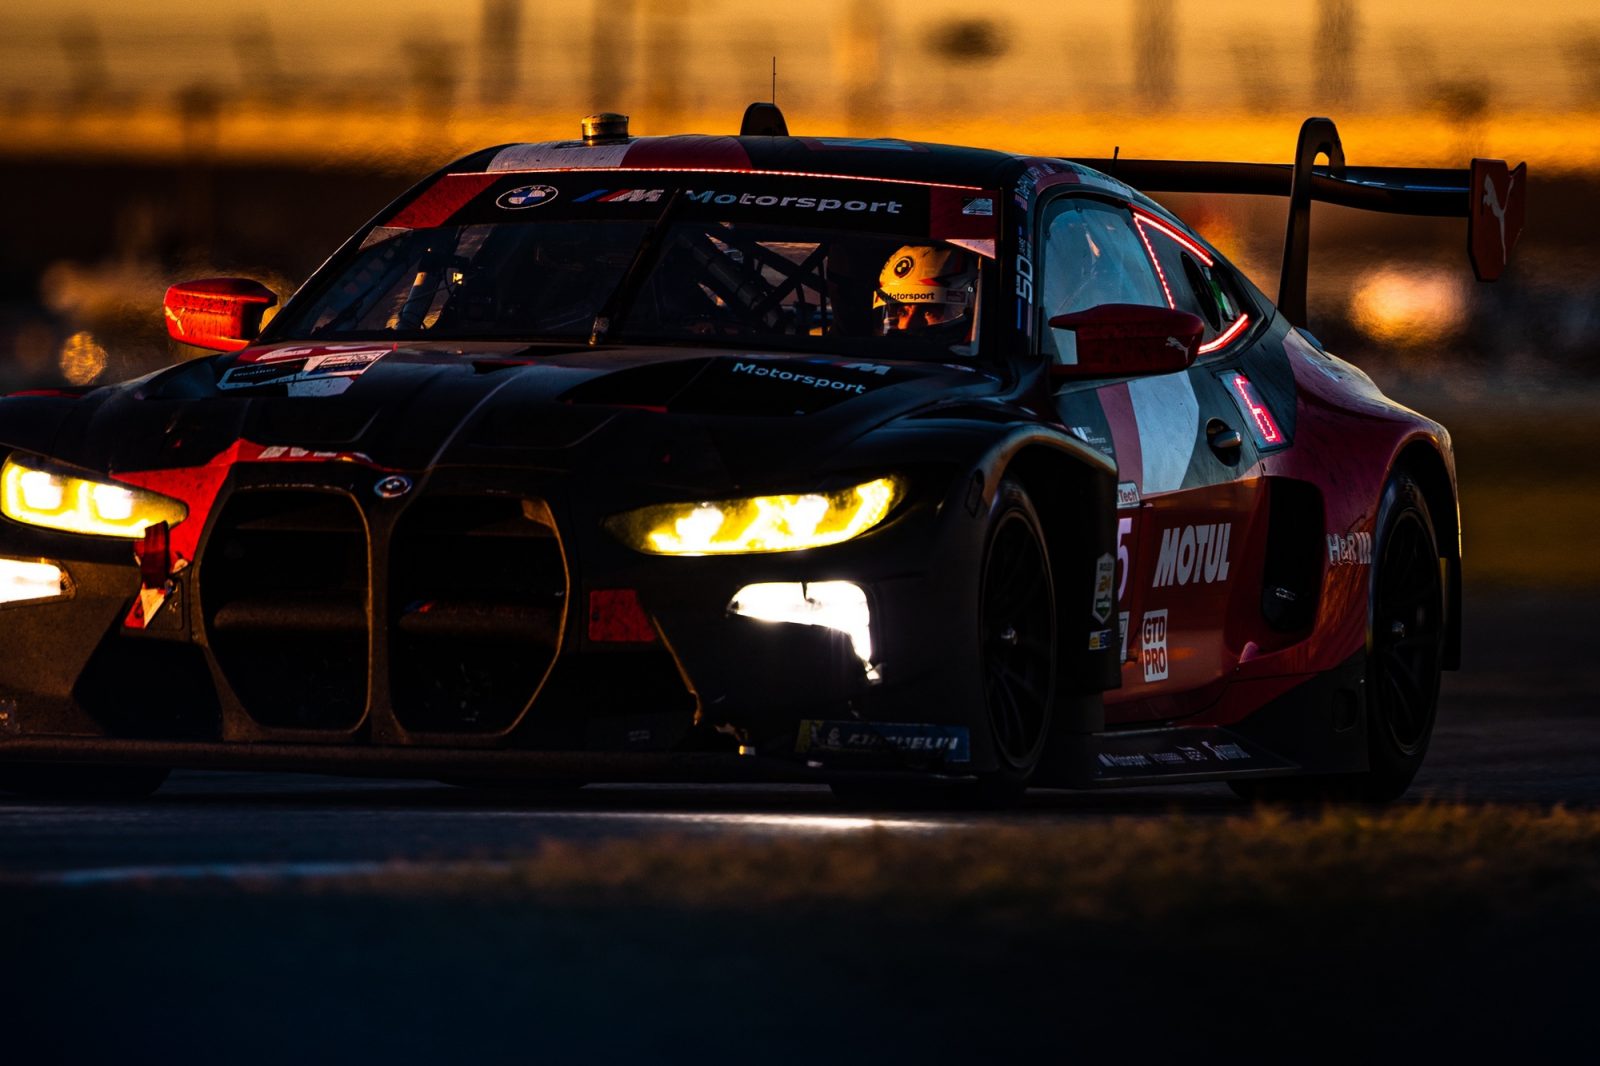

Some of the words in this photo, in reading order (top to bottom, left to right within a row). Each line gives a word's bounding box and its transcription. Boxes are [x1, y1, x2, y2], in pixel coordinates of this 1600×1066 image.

[684, 189, 903, 214] Motorsport
[732, 362, 867, 395] Motorsport
[1152, 522, 1232, 588] MOTUL
[1143, 615, 1166, 645] GTD
[1144, 646, 1166, 675] PRO
